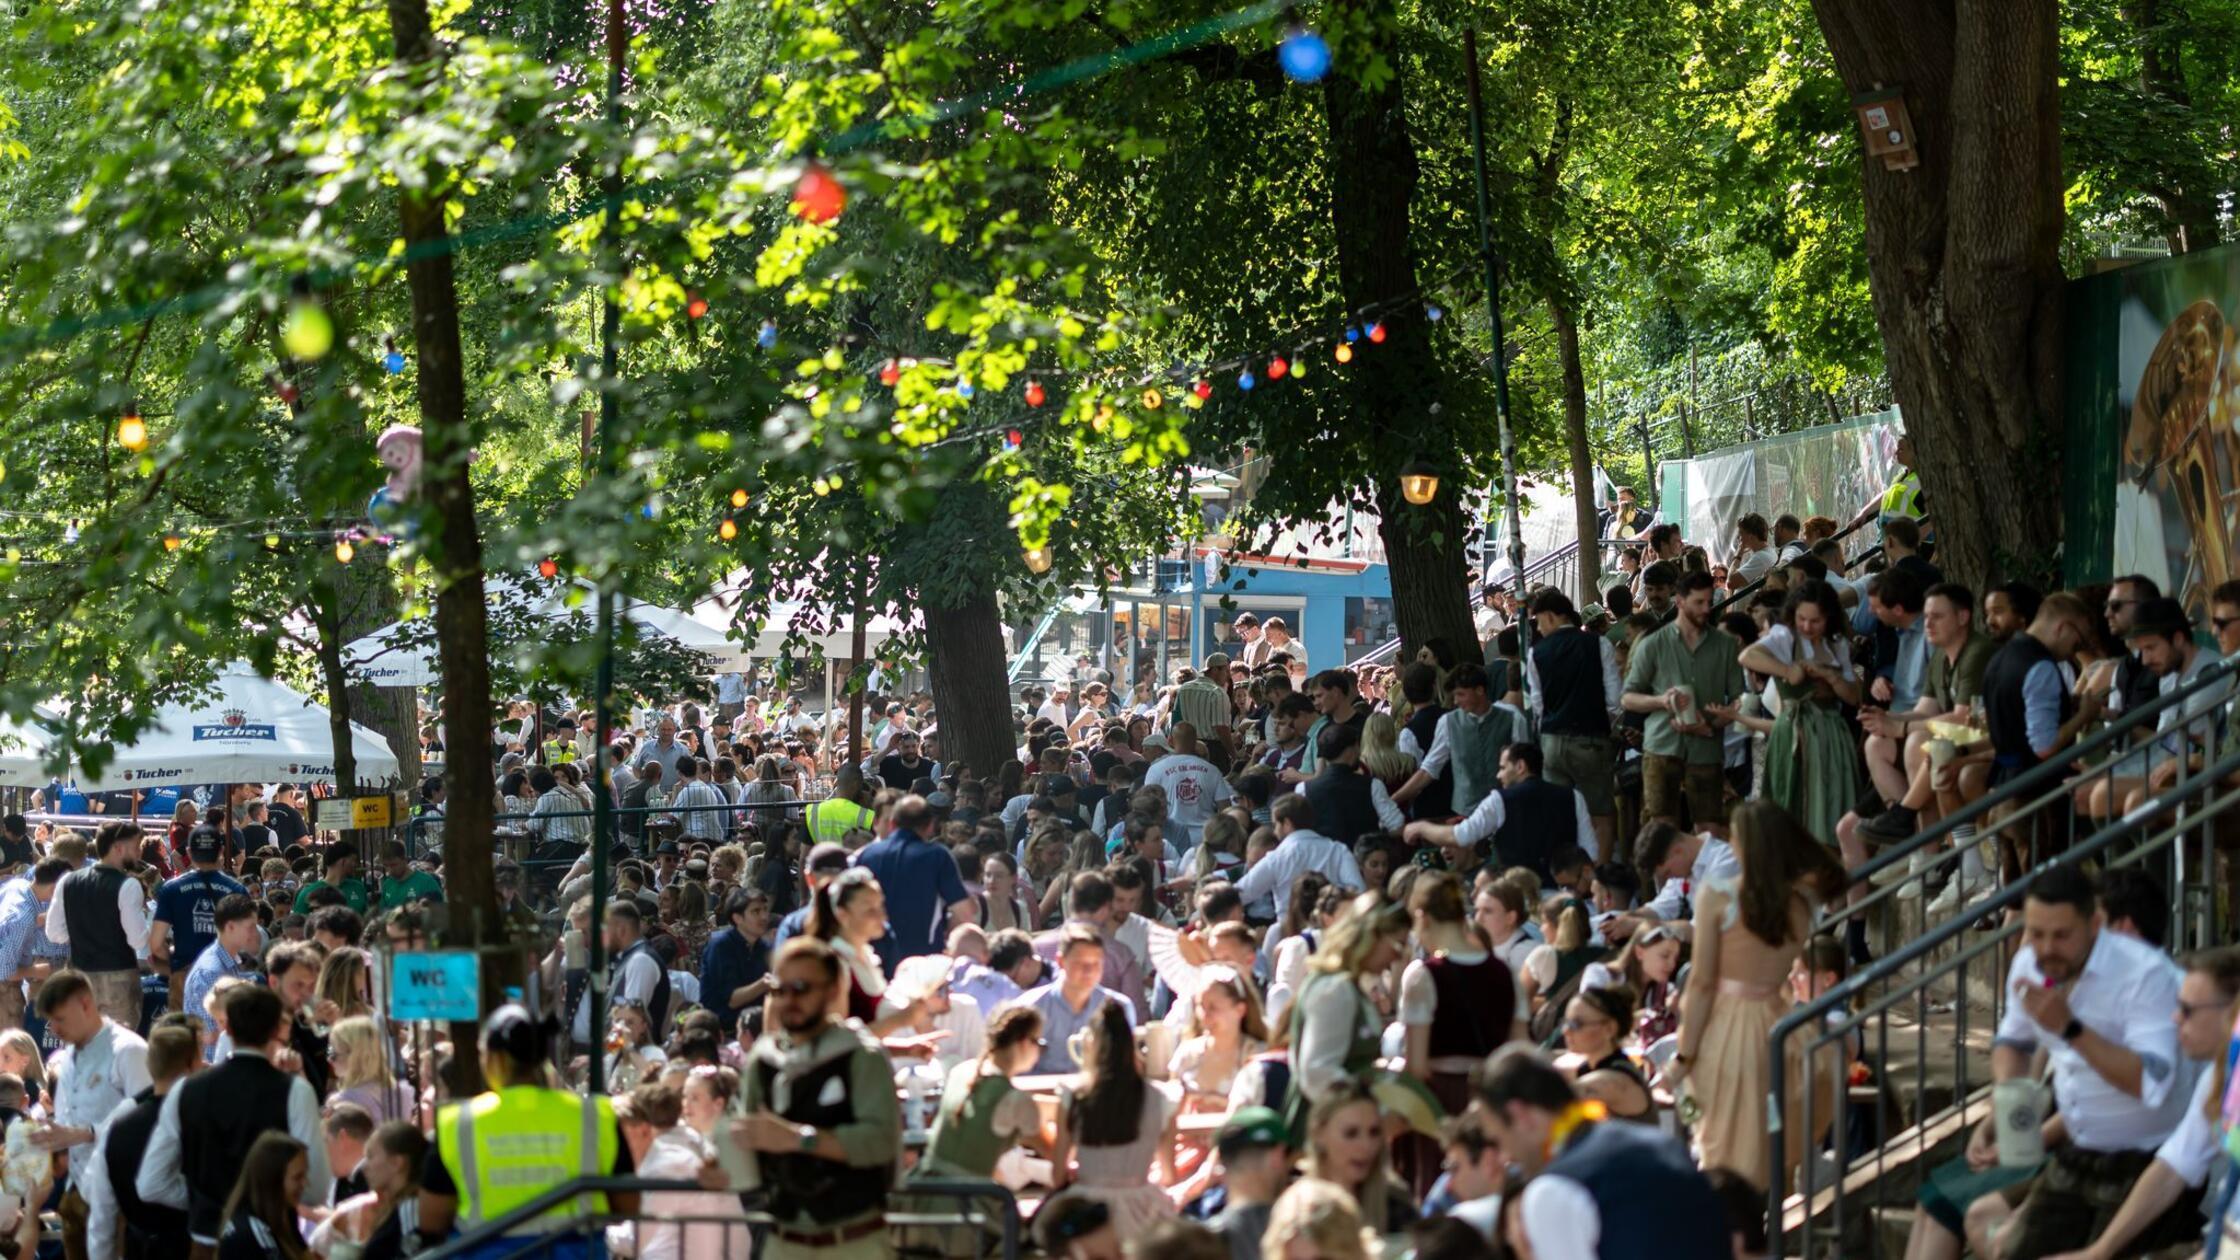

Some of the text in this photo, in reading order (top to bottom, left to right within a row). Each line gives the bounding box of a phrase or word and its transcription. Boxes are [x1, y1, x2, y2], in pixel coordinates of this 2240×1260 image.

[363, 667, 400, 678] Tucher
[201, 727, 270, 738] Tucher
[135, 767, 183, 780] Tucher
[301, 764, 337, 775] Tuche
[362, 803, 380, 813] WC
[410, 968, 447, 988] WC
